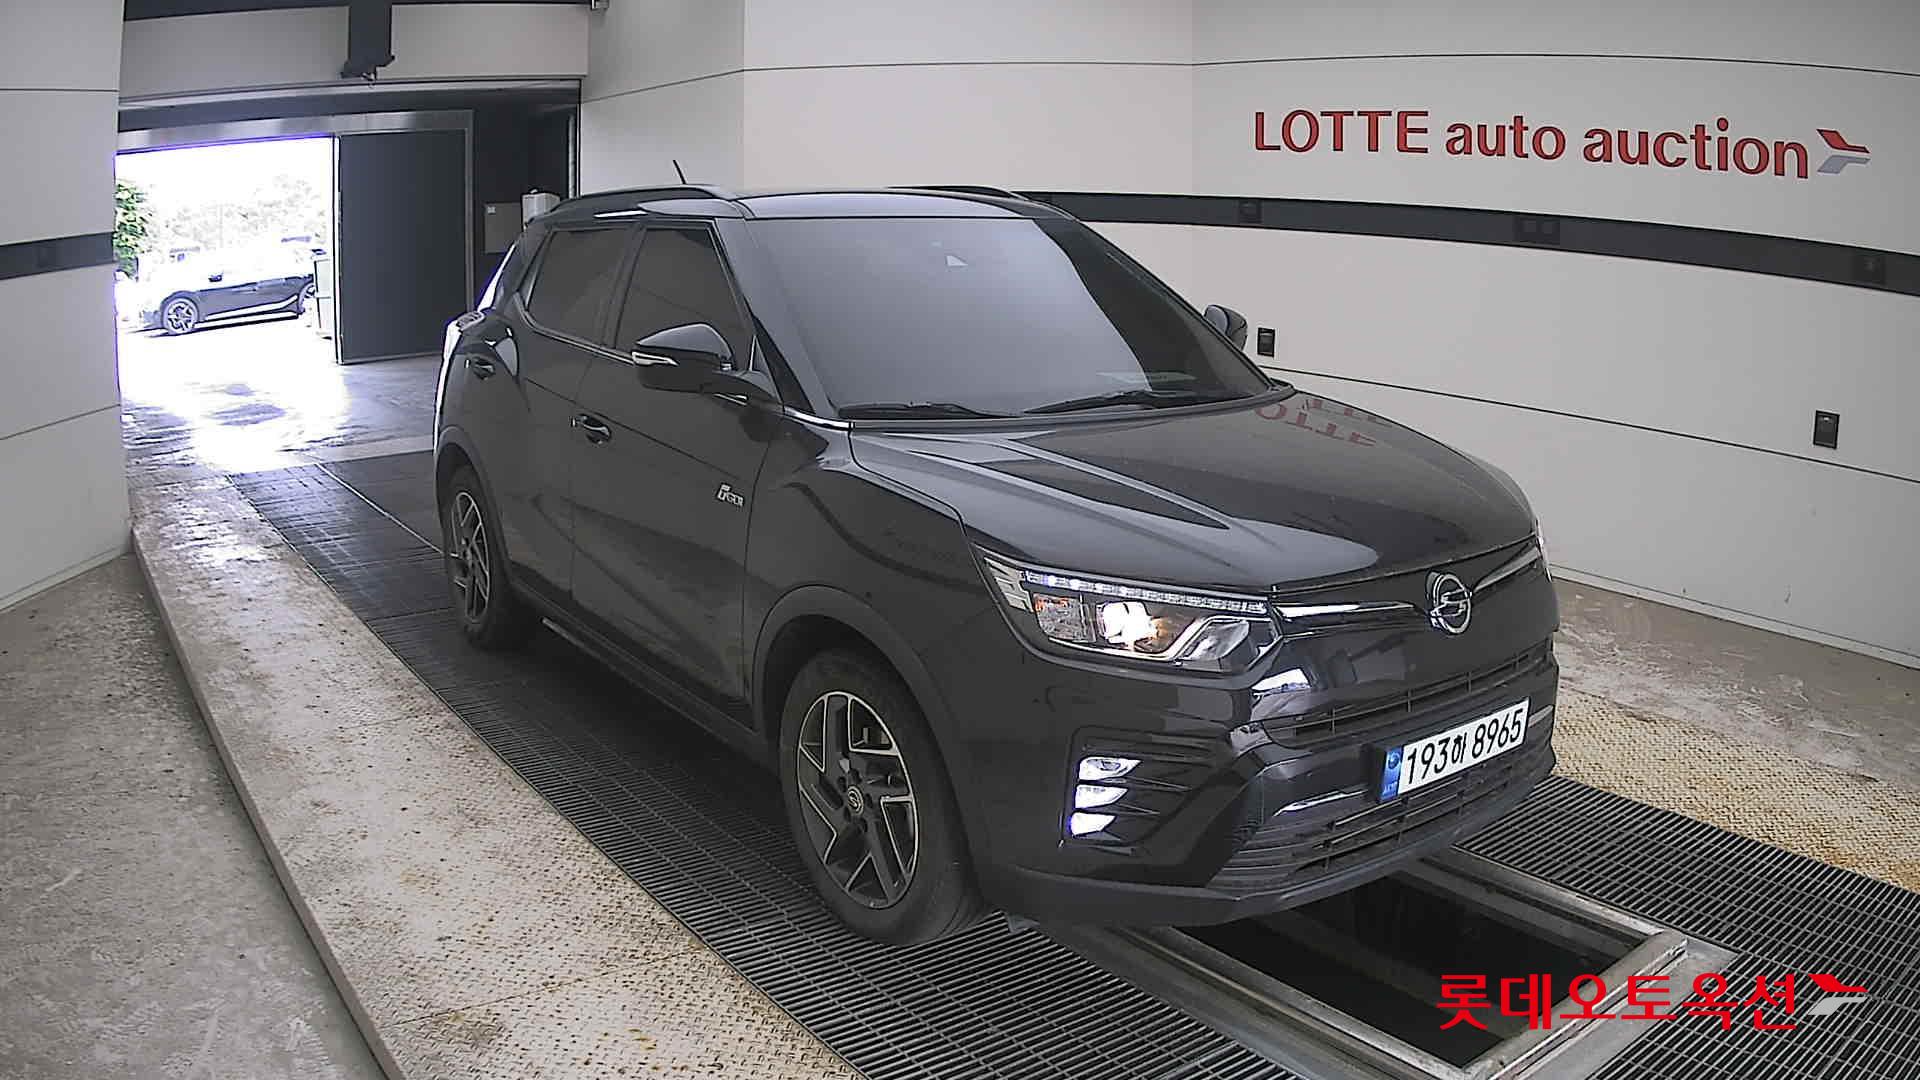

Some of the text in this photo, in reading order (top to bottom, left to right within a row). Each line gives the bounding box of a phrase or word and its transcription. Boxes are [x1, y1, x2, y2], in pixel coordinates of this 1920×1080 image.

[1254, 110, 1810, 179] LOTTE auto auction
[1407, 708, 1524, 785] 193하 8965
